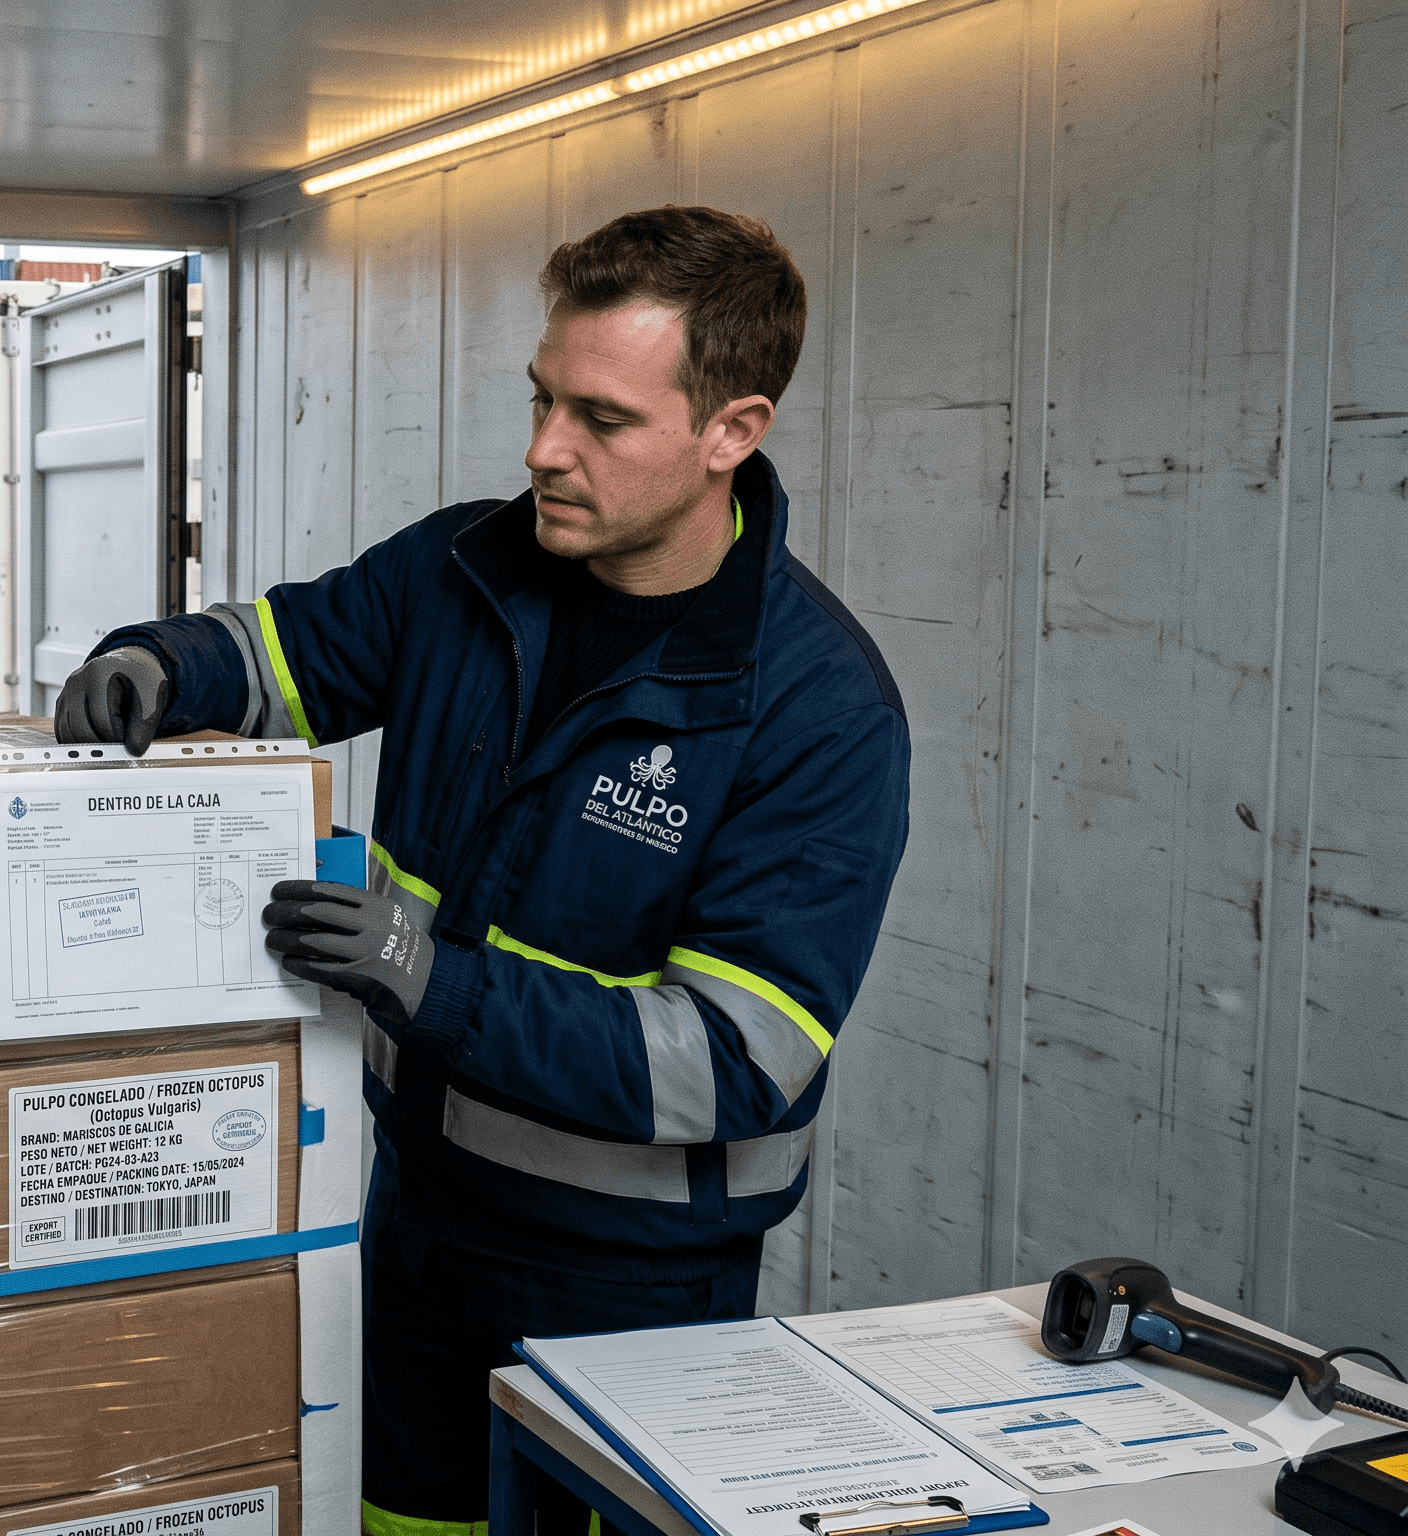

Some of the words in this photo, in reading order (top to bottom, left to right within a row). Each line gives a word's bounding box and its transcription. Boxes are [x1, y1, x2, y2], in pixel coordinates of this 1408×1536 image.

[88, 796, 141, 811] DENTRO
[147, 796, 163, 809] DE
[168, 795, 183, 808] LA
[188, 793, 220, 808] CAJA
[591, 774, 688, 827] PULPO
[585, 799, 609, 817] DEL
[611, 809, 682, 843] ATLANTICO
[24, 1095, 65, 1112] PULPO
[69, 1087, 144, 1107] CONGELADO
[148, 1085, 154, 1099] /
[157, 1080, 204, 1097] FROZEN
[208, 1074, 264, 1092] OCTOPUS
[90, 1107, 144, 1125] (Octopus
[148, 1098, 201, 1117] Vulgaris)
[21, 1132, 59, 1146] BRAND:
[63, 1126, 115, 1142] MARISCOS
[119, 1124, 131, 1136] DE
[135, 1120, 174, 1134] GALICIA
[21, 1149, 47, 1161] PESO
[51, 1145, 77, 1158] NETO
[80, 1145, 85, 1157] /
[87, 1142, 106, 1154] NET
[109, 1137, 151, 1152] WEIGHT:
[155, 1136, 166, 1147] 12
[169, 1134, 182, 1145] KG
[21, 1164, 46, 1177] LOTE
[49, 1163, 53, 1175] /
[56, 1159, 92, 1173] BATCH:
[21, 1178, 54, 1192] FECHA
[109, 1172, 114, 1183] /
[116, 1166, 159, 1181] PACKING
[162, 1163, 189, 1176] DATE:
[193, 1156, 244, 1172] 15/05/2024
[21, 1192, 65, 1207] DESTINO
[68, 1191, 72, 1202] /
[75, 1183, 144, 1201] DESTINATION:
[184, 1175, 216, 1188] JAPAN
[25, 1230, 62, 1242] CERTIFIED
[29, 1221, 58, 1232] EXPORT
[155, 1508, 204, 1531] FROZEN
[207, 1498, 265, 1520] OCTOPUS
